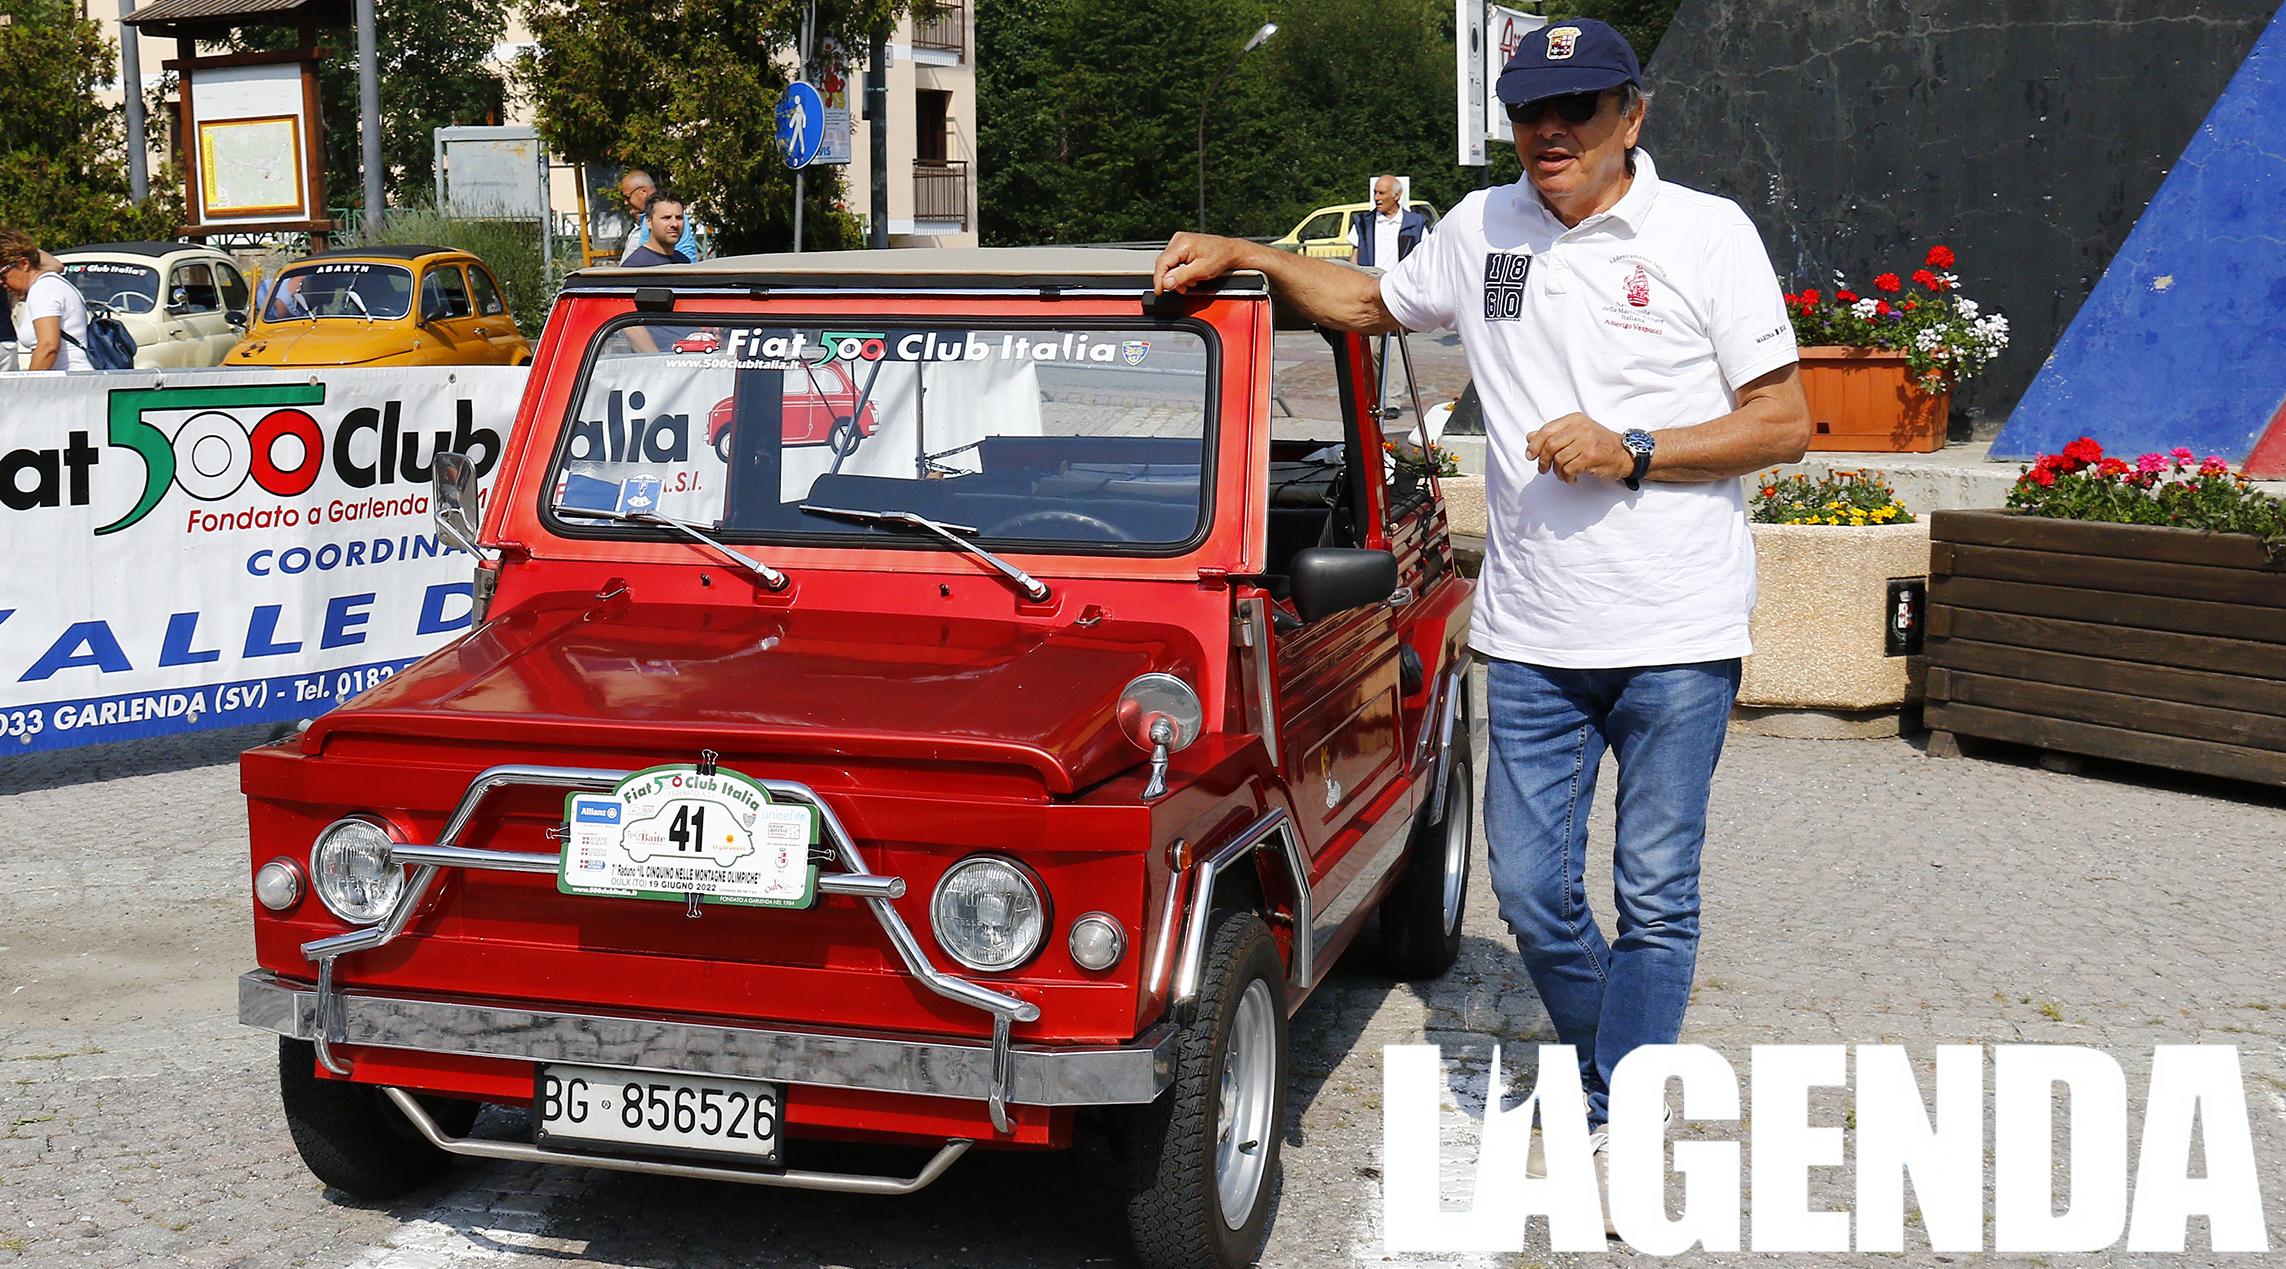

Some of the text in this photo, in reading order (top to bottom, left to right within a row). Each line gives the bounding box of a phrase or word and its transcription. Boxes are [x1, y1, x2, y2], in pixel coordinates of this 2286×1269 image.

[316, 264, 370, 274] ABARTH
[1604, 319, 1662, 336] Amerigo Vespucci
[726, 328, 1117, 369] Fiat 500 Club Italia
[94, 383, 326, 536] 500
[332, 400, 501, 489] Club
[187, 505, 300, 534] Fondato
[307, 506, 322, 525] a
[328, 493, 429, 523] Garlenda
[0, 592, 376, 683] ALLE
[53, 691, 206, 731] GARLENDA
[215, 680, 268, 714] (SV)
[294, 675, 330, 702] Tel.
[581, 807, 607, 817] Allianz
[623, 783, 652, 804] Fiat
[685, 776, 718, 792] Club
[721, 782, 760, 811] Italia
[668, 805, 705, 853] 41
[611, 877, 630, 887] OULX
[632, 879, 647, 888] (TO)
[649, 880, 659, 888] 19
[661, 881, 694, 890] GIUGNO
[696, 883, 717, 892] 2022
[618, 864, 636, 877] Raduno
[646, 866, 674, 880] CINQUINO
[675, 868, 694, 881] NELLE
[695, 869, 726, 883] MONTAGNE
[720, 895, 744, 904] FONDATO
[543, 1074, 776, 1141] BG 856526
